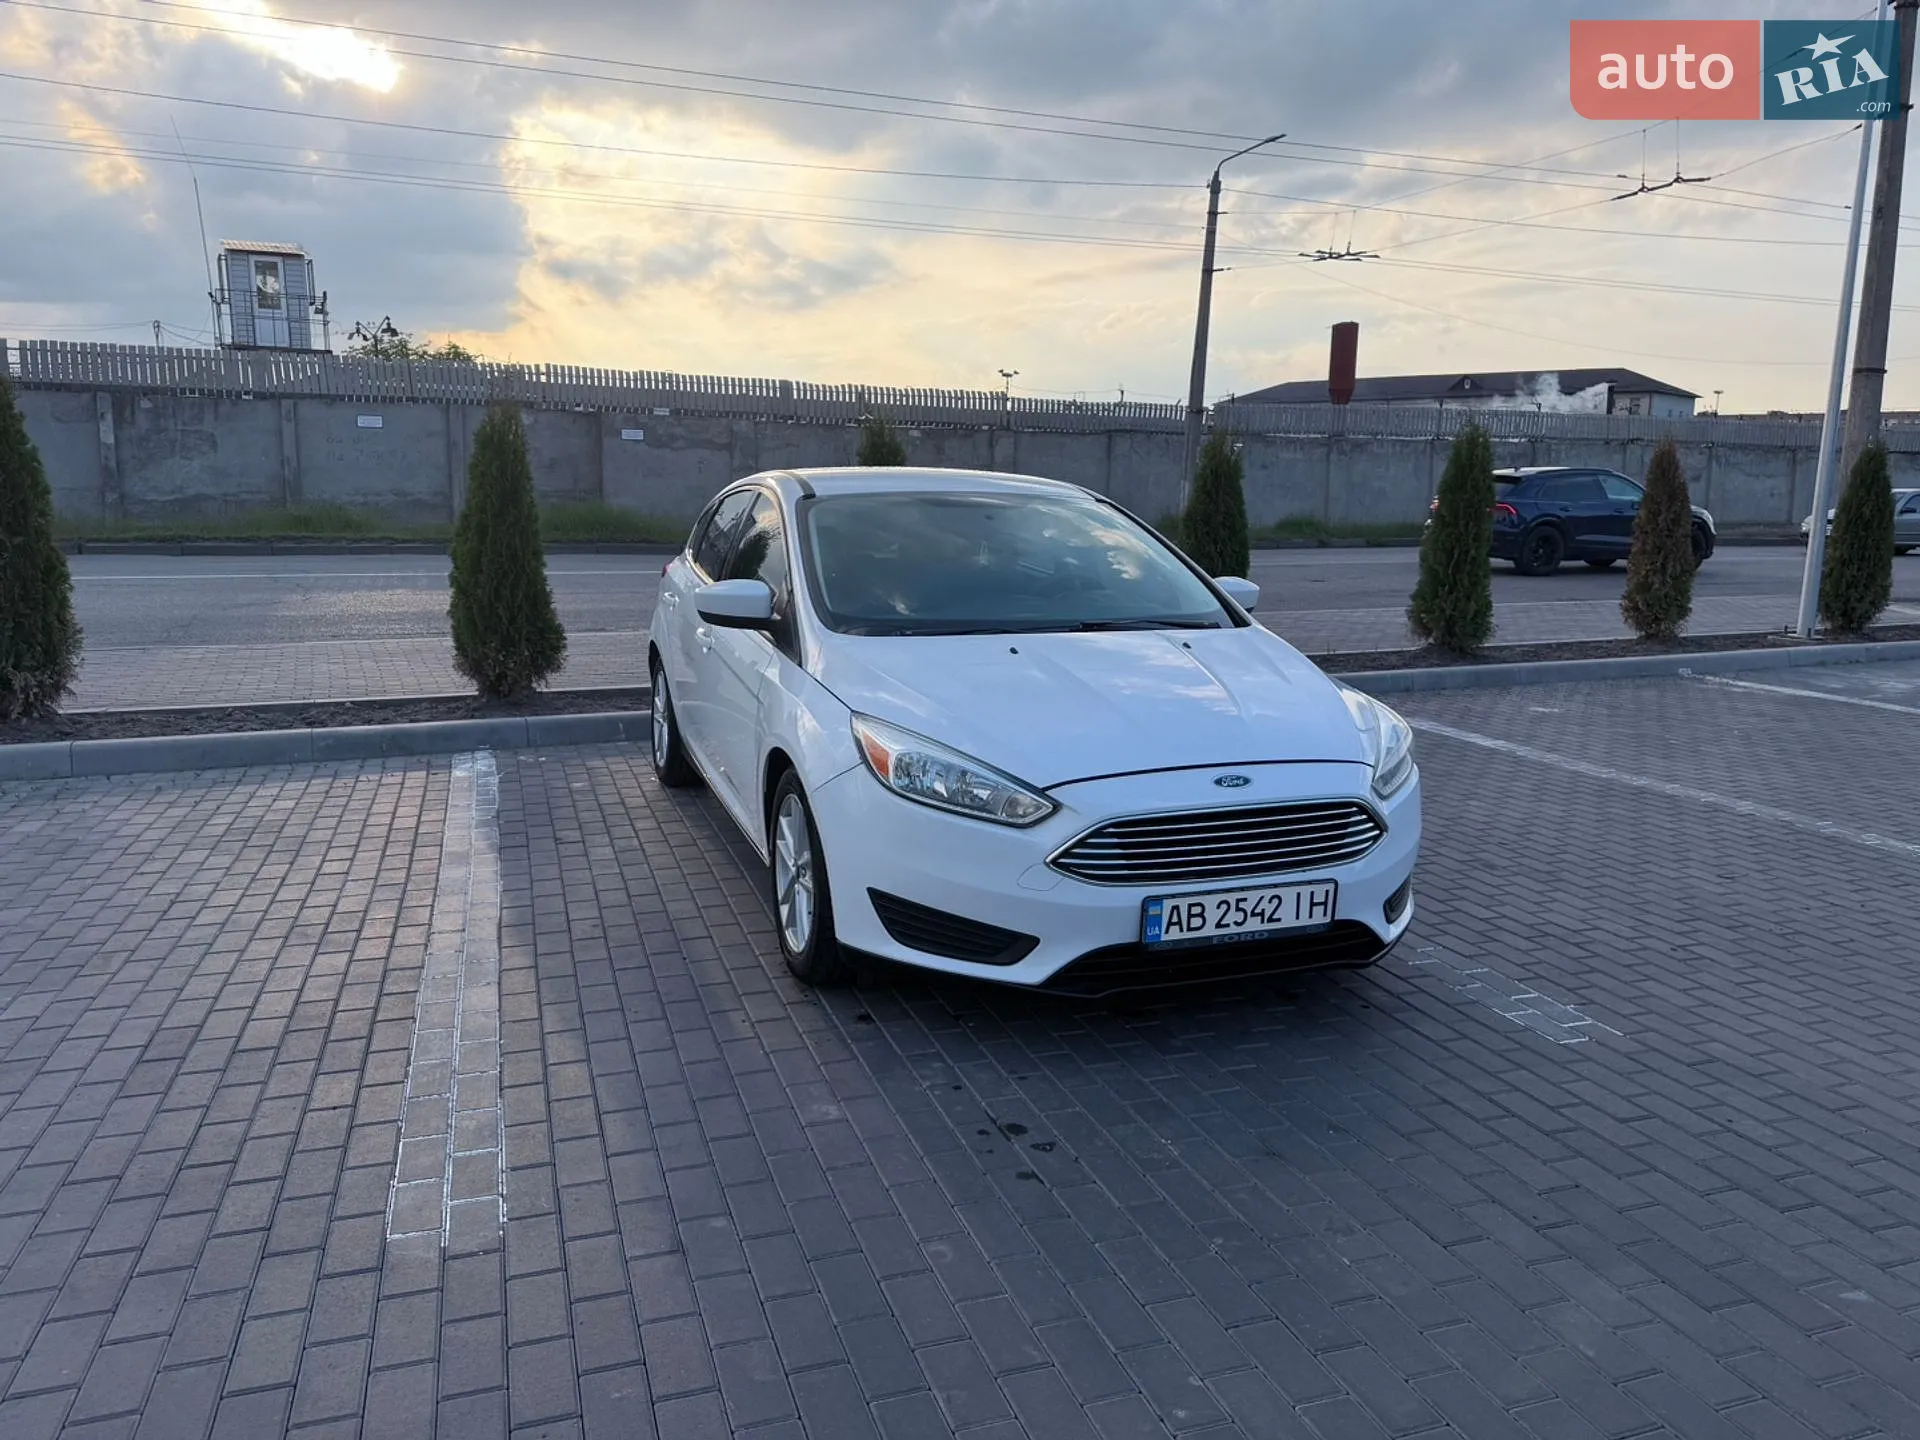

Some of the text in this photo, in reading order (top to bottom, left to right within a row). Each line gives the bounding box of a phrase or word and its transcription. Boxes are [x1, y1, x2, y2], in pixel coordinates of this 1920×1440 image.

[1164, 888, 1330, 935] AB 2542 IH
[1146, 926, 1160, 936] UA
[1212, 931, 1269, 945] FORD
